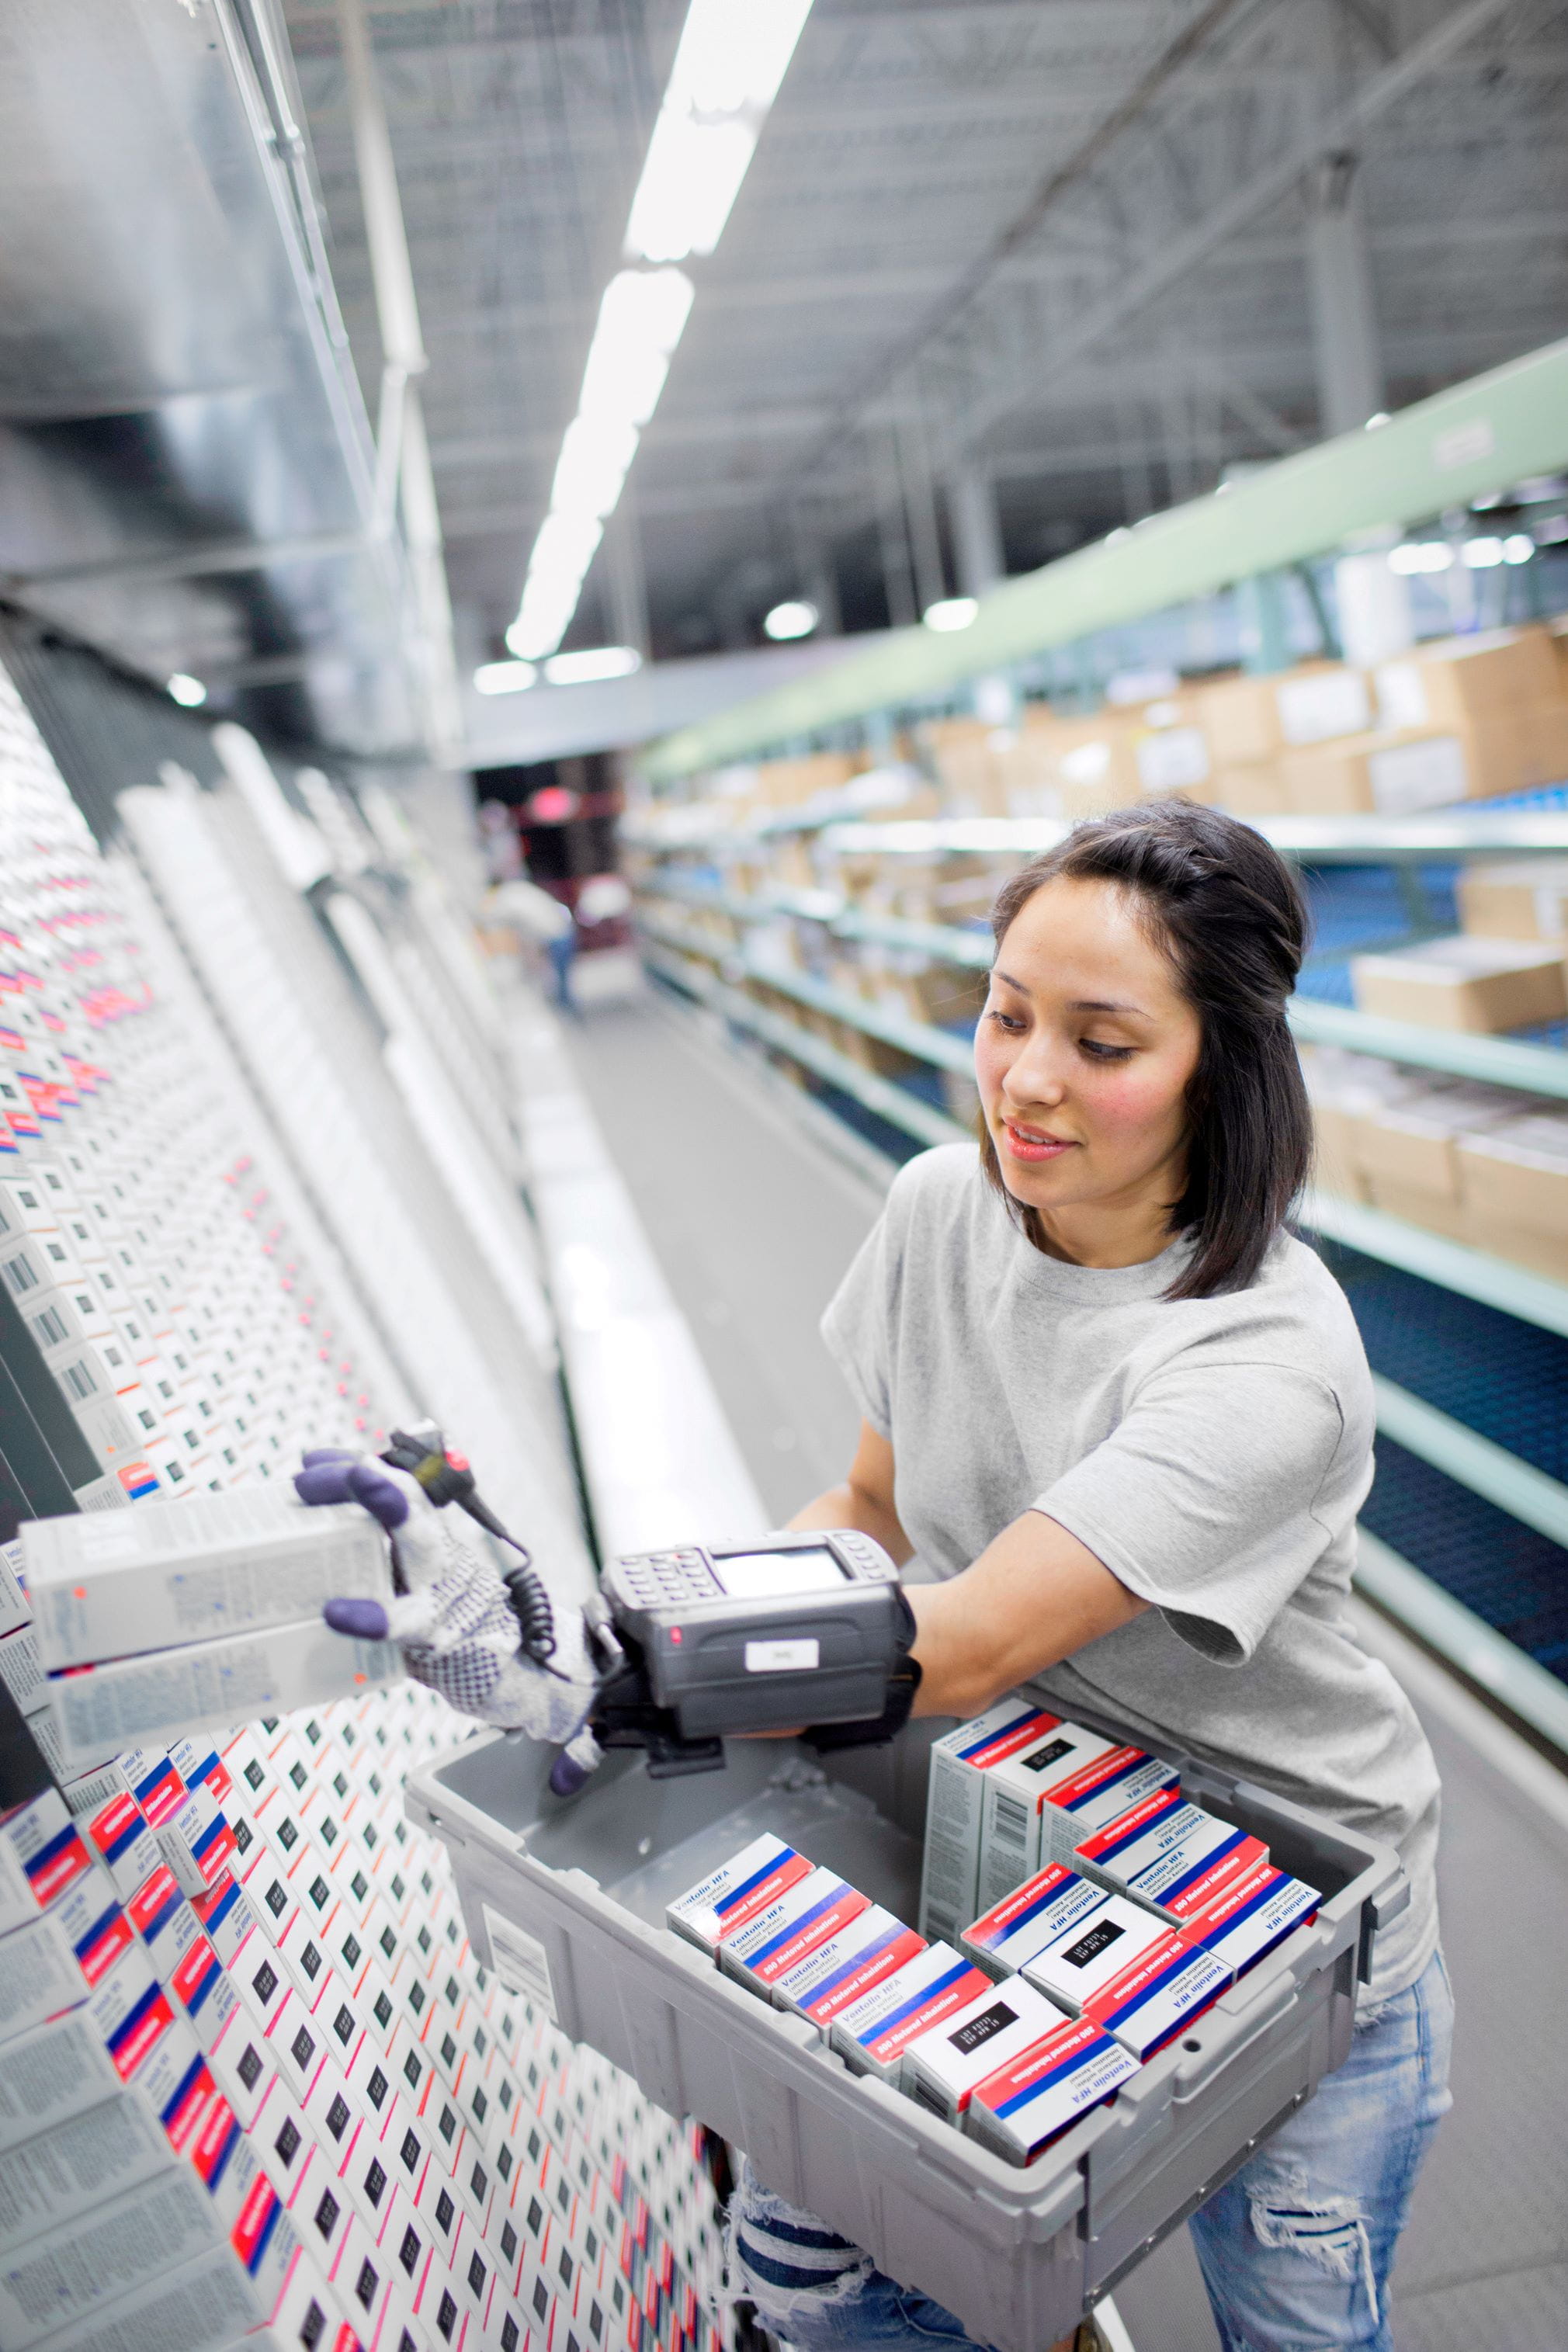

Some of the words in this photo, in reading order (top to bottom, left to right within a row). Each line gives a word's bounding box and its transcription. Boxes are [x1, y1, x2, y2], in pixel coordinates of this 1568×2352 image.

[1124, 1788, 1143, 1799] HFA
[1174, 1815, 1205, 1836] Ventolin
[1156, 1836, 1174, 1848] HFA
[712, 1870, 730, 1884] HFA
[1047, 1868, 1062, 1880] 200
[1136, 1864, 1167, 1888] Ventolin
[1167, 1850, 1185, 1864] HFA
[1259, 1868, 1272, 1879] 200
[1024, 1877, 1050, 1899] Metered
[1174, 1899, 1188, 1911] 200
[1185, 1880, 1211, 1902] Metered
[1208, 1856, 1240, 1883] Inhalations
[1237, 1876, 1262, 1898] Metered
[992, 1896, 1027, 1924] Inhalations
[1067, 1891, 1100, 1916] Ventolin
[1208, 1895, 1240, 1922] Inhalations
[1282, 1891, 1313, 1917] Ventolin
[729, 1919, 765, 1947] Ventolin
[767, 1905, 785, 1919] HFA
[1048, 1916, 1067, 1930] HFA
[1264, 1916, 1282, 1930] HFA
[763, 1961, 778, 1975] 200
[776, 1939, 805, 1964] Metered
[803, 1912, 839, 1943] Inhalations
[1074, 1946, 1084, 1955] LOT
[1079, 1950, 1089, 1958] EXP
[1090, 1941, 1100, 1950] APR
[1168, 1941, 1183, 1954] 200
[781, 1957, 817, 1986] Ventolin
[820, 1942, 838, 1958] HFA
[1145, 1950, 1171, 1973] Metered
[816, 2001, 831, 2016] 200
[829, 1980, 859, 2005] Metered
[857, 1952, 893, 1983] Inhalations
[1113, 1970, 1147, 2000] Inhalations
[1191, 1965, 1224, 1993] Ventolin
[841, 1993, 879, 2021] Ventolin
[882, 1978, 902, 1994] HFA
[1172, 1993, 1191, 2008] HFA
[876, 2039, 893, 2054] 200
[891, 2018, 921, 2043] Metered
[920, 1991, 958, 2022] Inhalations
[1079, 2024, 1095, 2038] 200
[960, 2030, 971, 2039] LOT
[966, 2035, 976, 2045] EXP
[978, 2026, 990, 2035] APR
[1049, 2035, 1081, 2059] Metered
[1011, 2054, 1052, 2085] Inhalations
[1093, 2060, 1132, 2089] Ventolin
[1070, 2087, 1091, 2104] HFA
